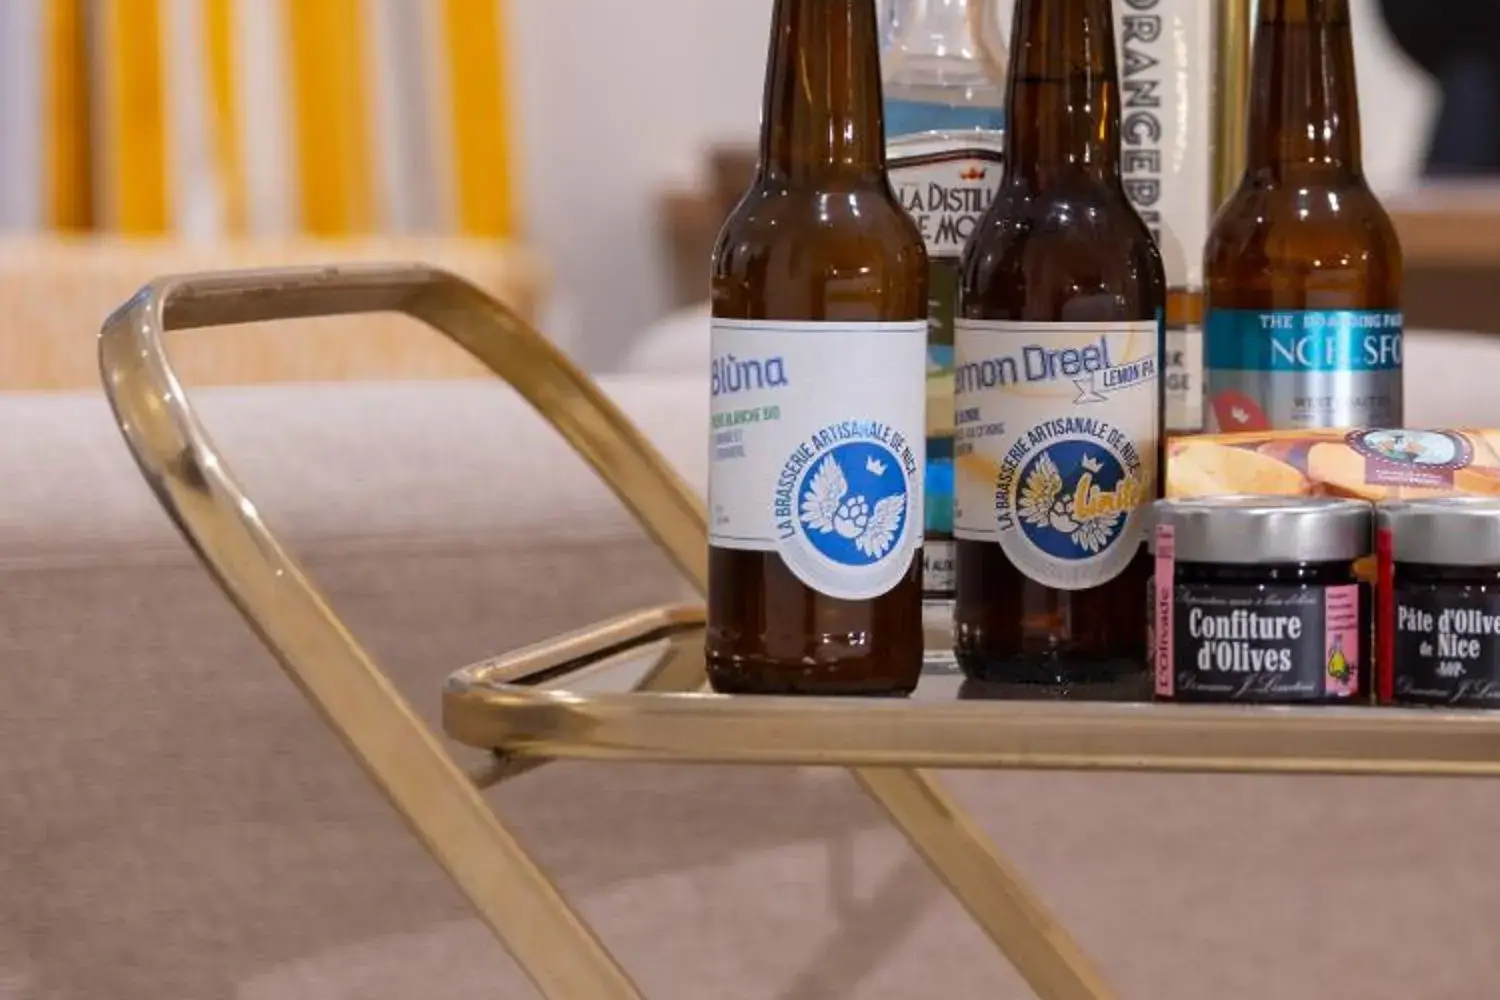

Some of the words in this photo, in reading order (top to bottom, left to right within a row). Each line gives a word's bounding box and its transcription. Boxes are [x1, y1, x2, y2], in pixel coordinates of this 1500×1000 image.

[1259, 314, 1294, 329] THE
[811, 421, 890, 451] ARTISANALE
[1027, 417, 1109, 446] ARTISANALE
[1107, 428, 1126, 449] DE
[775, 442, 815, 517] BRASSERIE
[996, 438, 1030, 509] BRASSERIE
[777, 520, 795, 539] LA
[997, 512, 1015, 531] LA
[1189, 607, 1302, 640] Confiture
[1397, 605, 1433, 631] Pâte
[1197, 640, 1292, 672] d'Olives
[1437, 634, 1481, 659] Nice
